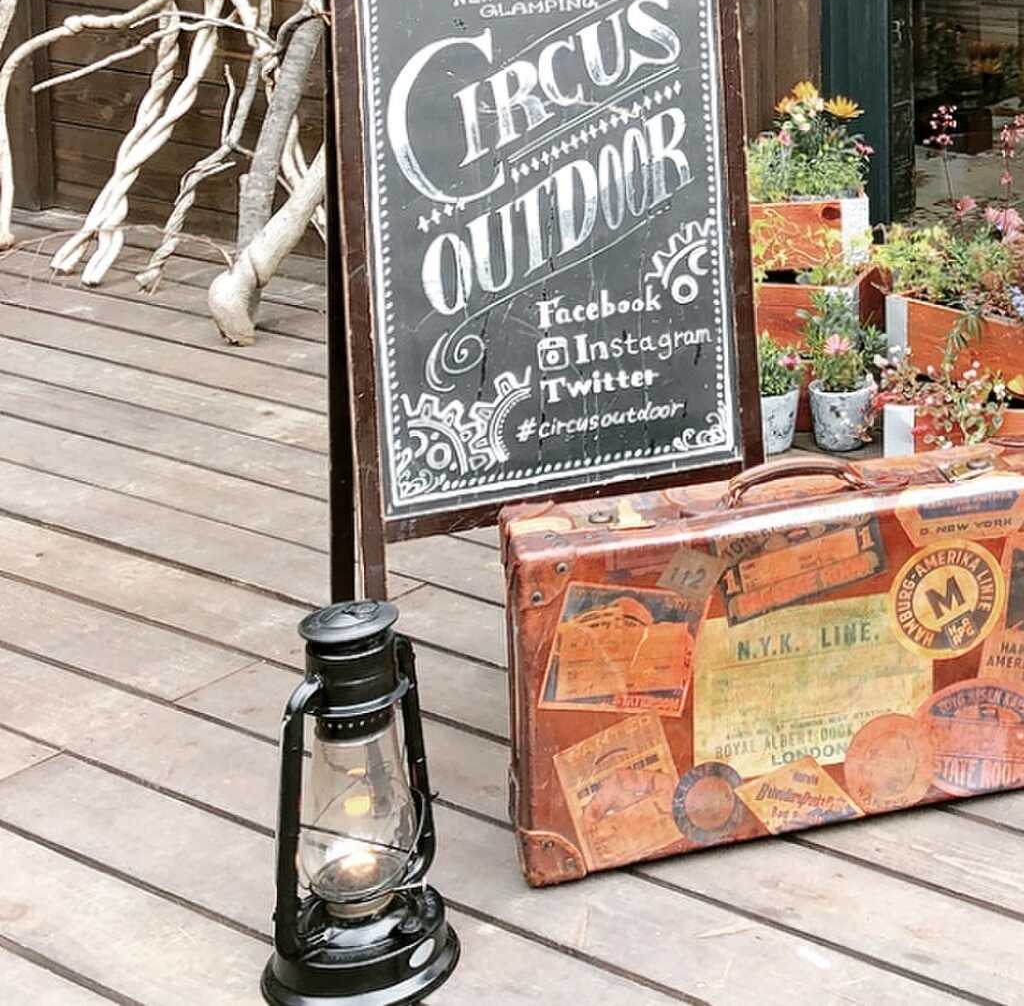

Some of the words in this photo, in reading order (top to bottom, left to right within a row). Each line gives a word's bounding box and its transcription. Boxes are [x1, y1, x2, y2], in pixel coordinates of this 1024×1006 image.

[421, 107, 695, 315] OUTDOOR
[536, 285, 662, 329] Facebook
[573, 328, 712, 364] Instagram
[540, 369, 660, 403] Twitter
[516, 400, 685, 442] #circusoutdoor
[975, 518, 1013, 529] YORK
[924, 576, 966, 620] M
[977, 569, 995, 612] LINIE
